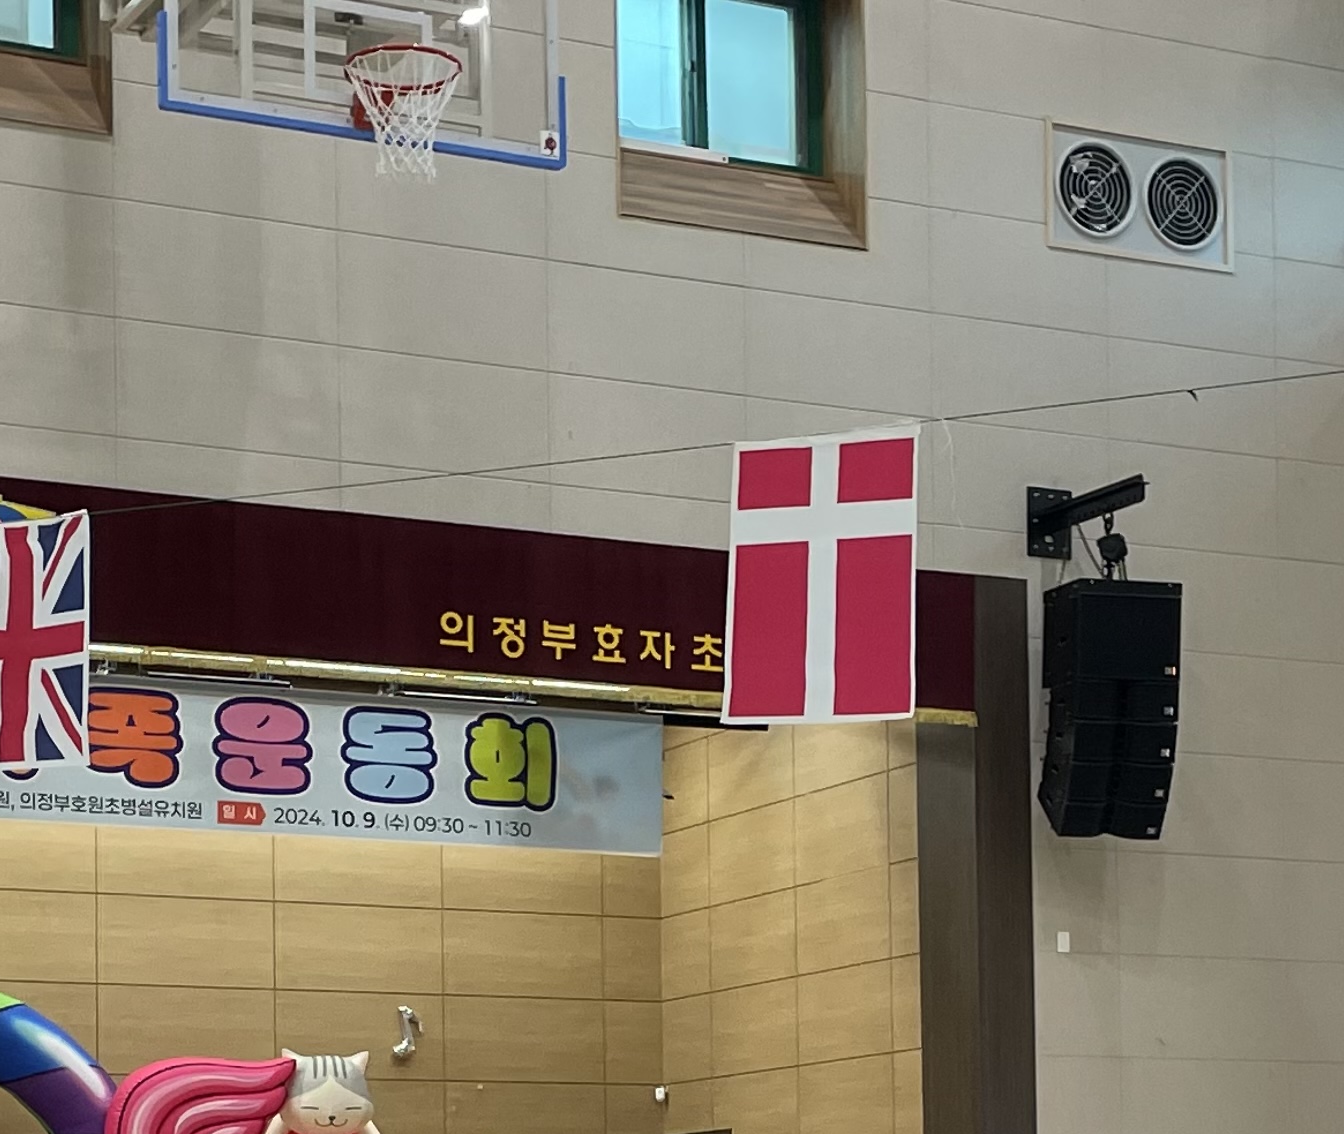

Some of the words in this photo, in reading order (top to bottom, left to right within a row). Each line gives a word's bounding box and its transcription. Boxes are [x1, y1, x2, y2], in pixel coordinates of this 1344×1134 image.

[19, 792, 202, 819] 의정부호원초병설유치원
[274, 807, 326, 827] 2024.
[385, 813, 410, 833] (수)
[413, 816, 465, 834] 09:30
[484, 819, 532, 838] 11:30
